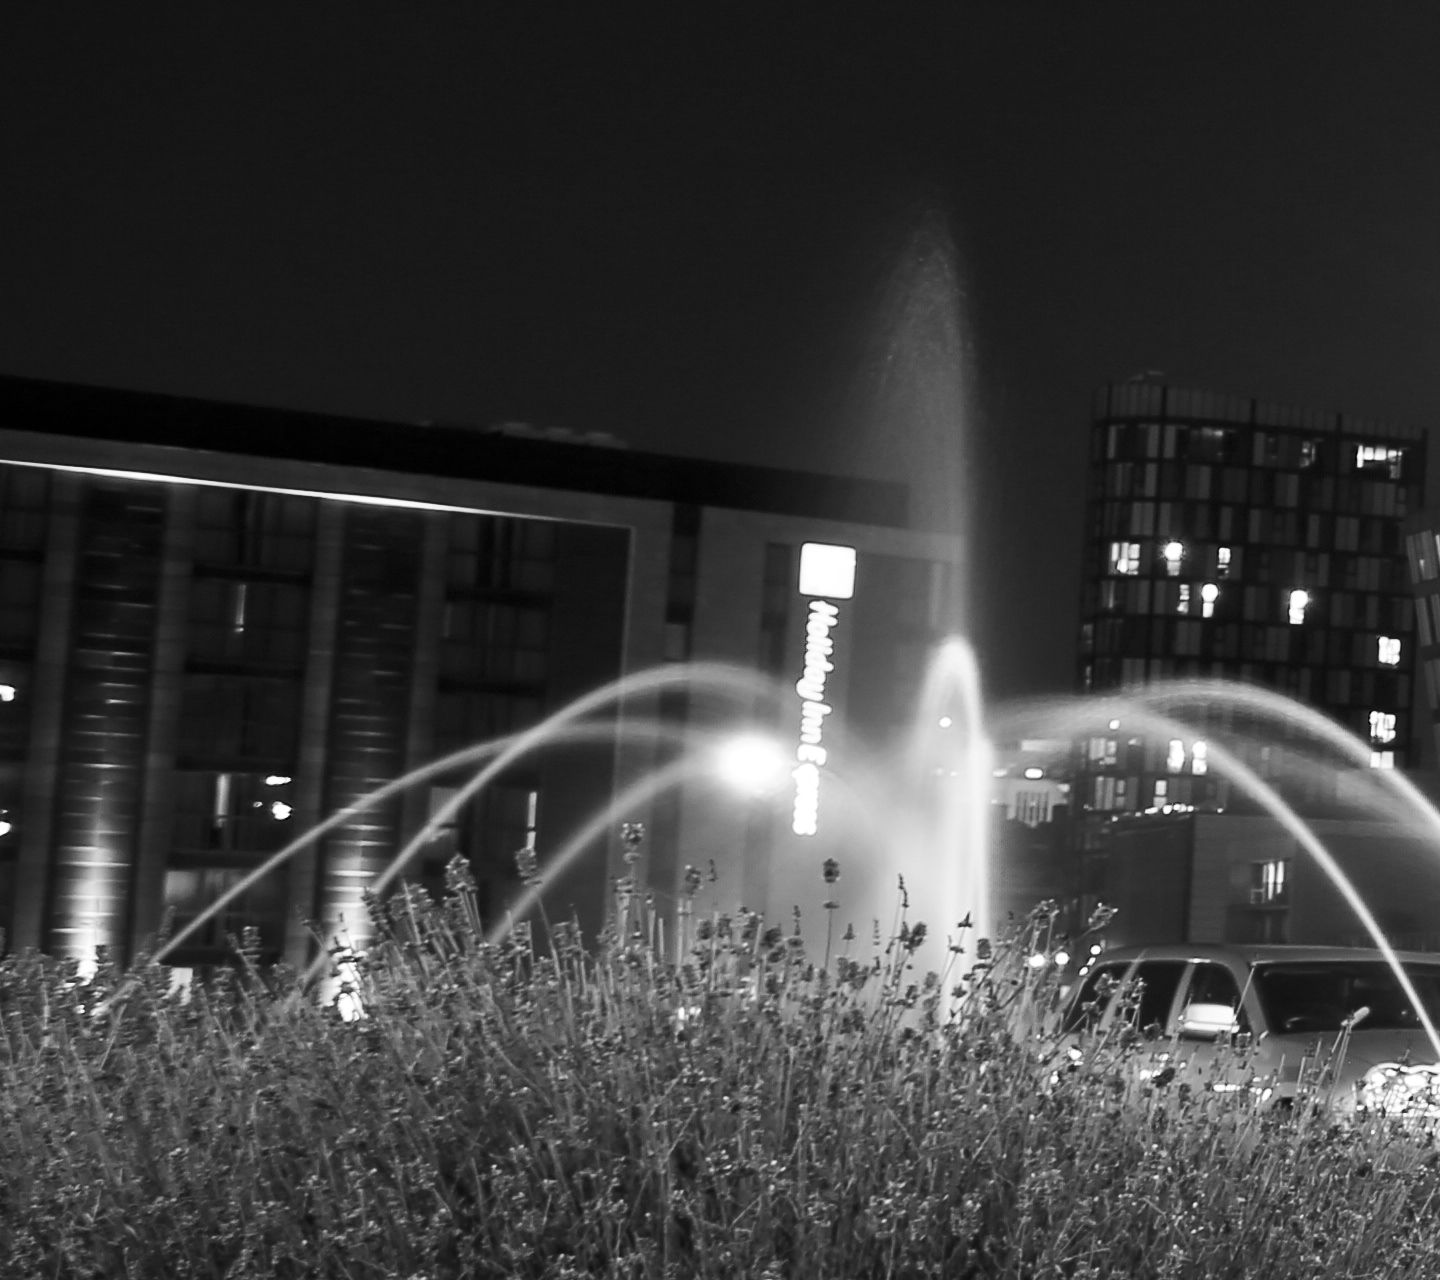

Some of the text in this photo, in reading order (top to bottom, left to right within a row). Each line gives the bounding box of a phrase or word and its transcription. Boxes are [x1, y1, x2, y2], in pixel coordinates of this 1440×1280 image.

[791, 599, 840, 836] Holiday Inn Epress
